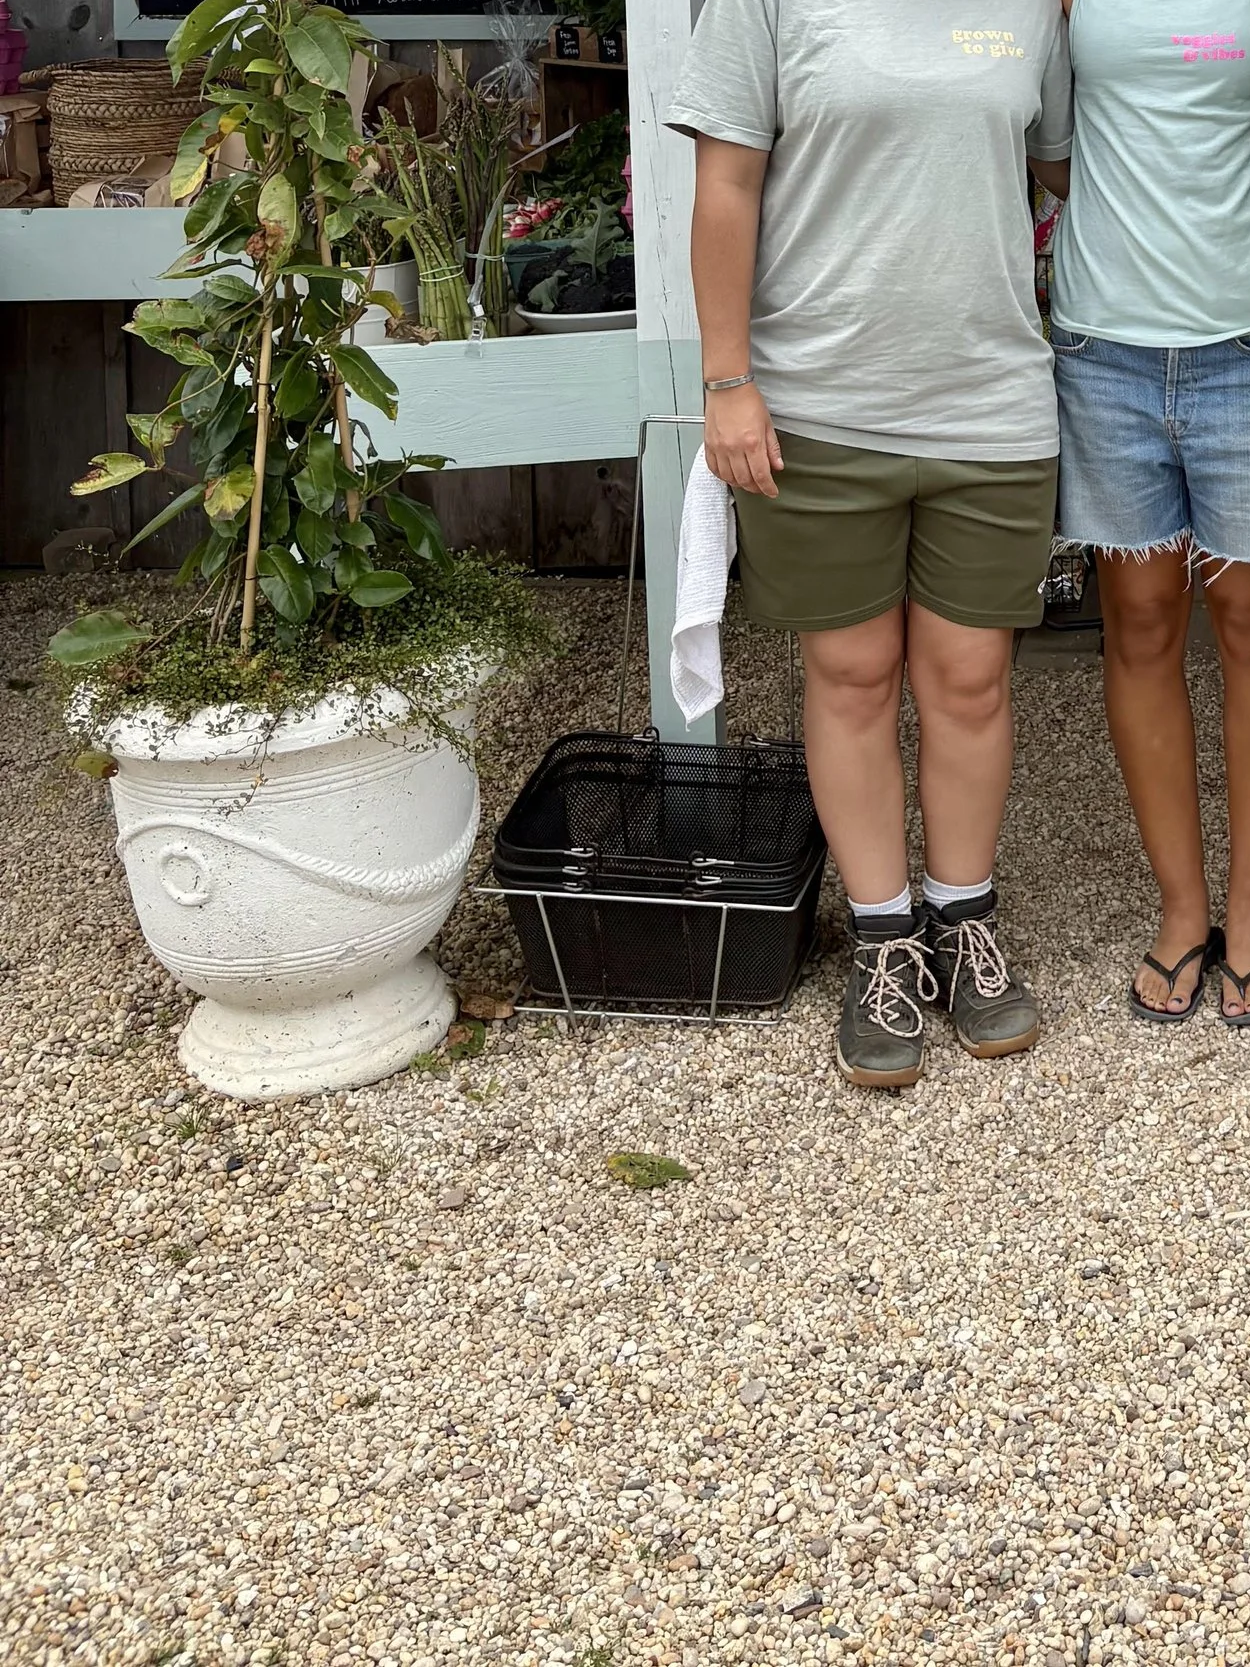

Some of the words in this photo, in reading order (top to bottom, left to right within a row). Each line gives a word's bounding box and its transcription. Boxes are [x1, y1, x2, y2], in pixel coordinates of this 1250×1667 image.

[952, 29, 1015, 44] grown
[962, 42, 984, 54] to
[989, 41, 1025, 60] give
